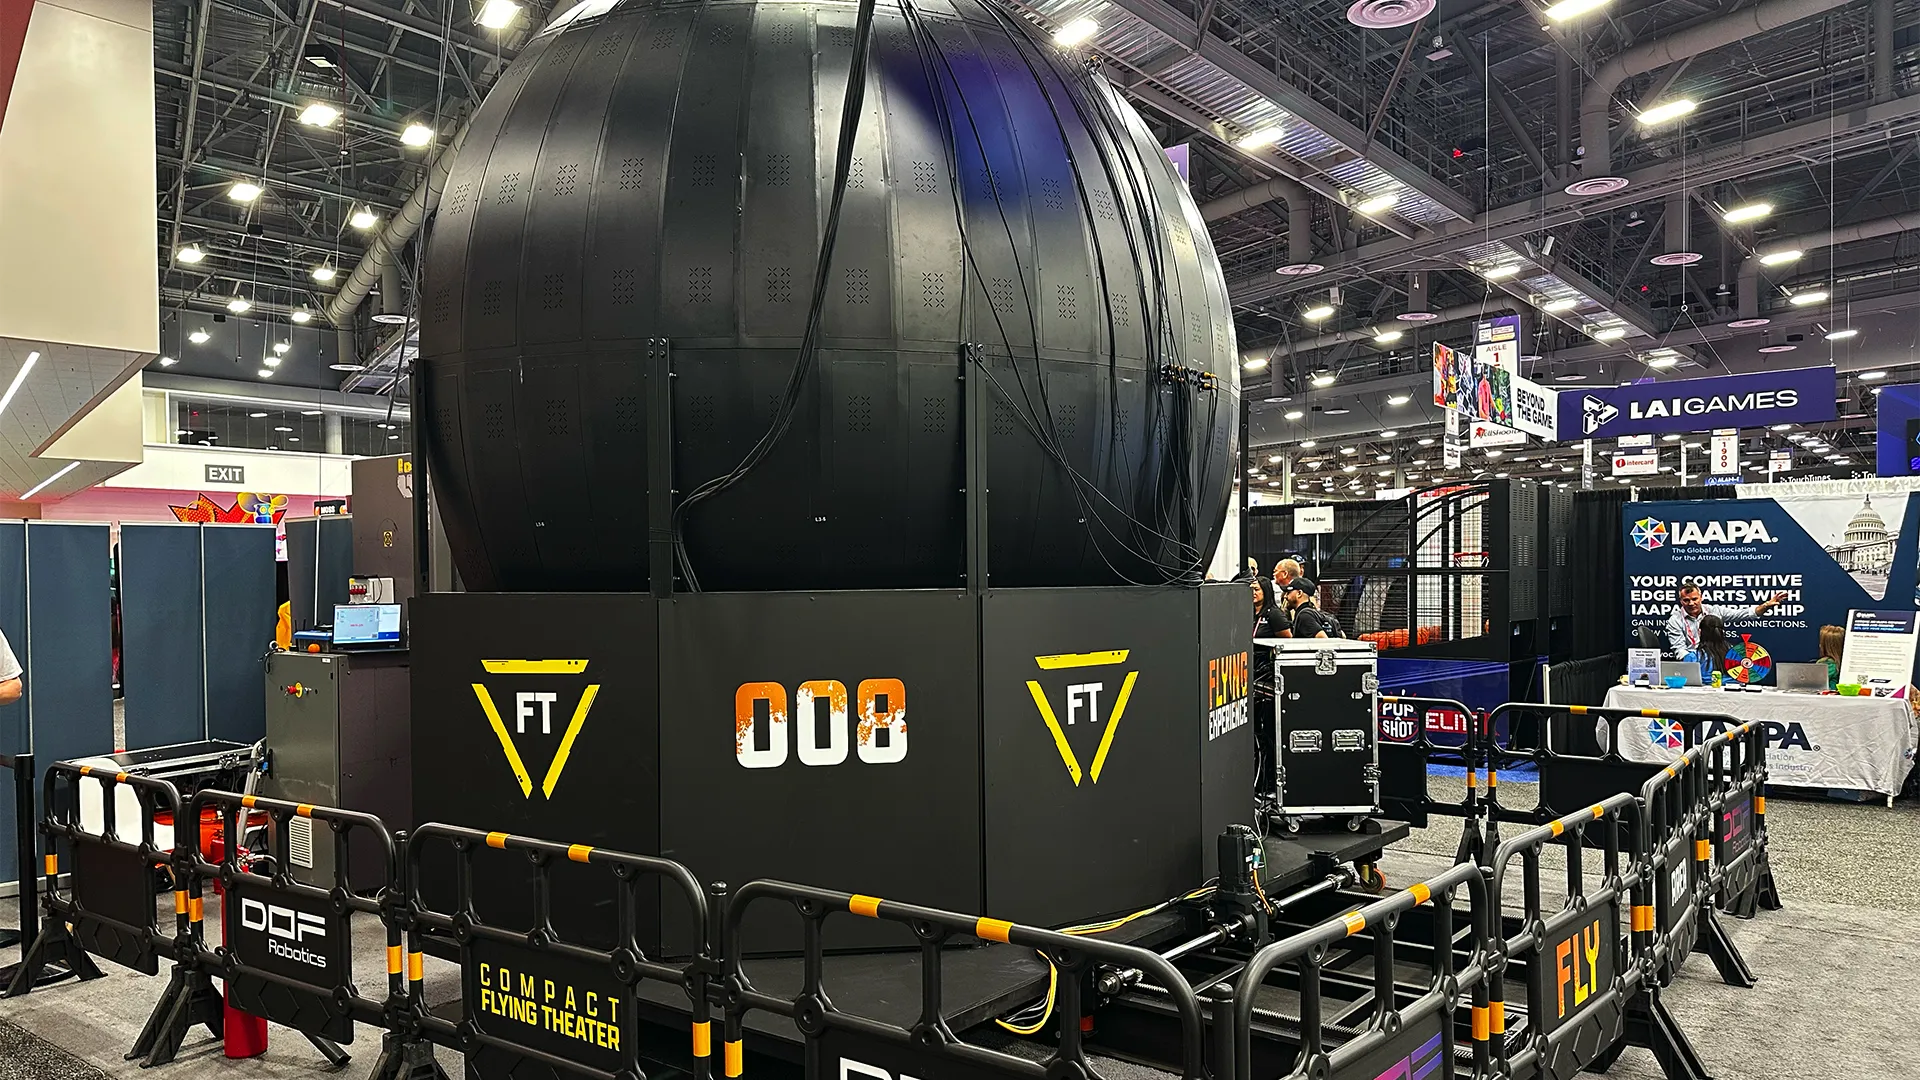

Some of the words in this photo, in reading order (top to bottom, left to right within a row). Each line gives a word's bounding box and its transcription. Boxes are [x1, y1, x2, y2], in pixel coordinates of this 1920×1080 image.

[1486, 344, 1507, 352] AISLE
[1517, 388, 1544, 410] BEYOND
[1517, 405, 1532, 422] THE
[209, 467, 242, 482] EXIT
[1630, 576, 1677, 587] YOUR
[1682, 574, 1802, 587] COMPETITIVE
[1630, 590, 1676, 601] EDGE
[1209, 652, 1247, 710] FLYING
[516, 692, 557, 734] FT
[1067, 682, 1103, 725] FT
[1209, 696, 1247, 741] EXPERIENCE
[736, 678, 908, 768] 008
[1382, 720, 1414, 738] SHOT
[1776, 763, 1812, 772] Industry
[242, 898, 325, 942] DOF
[269, 938, 326, 968] Robotics
[1556, 920, 1599, 1019] FLY
[480, 963, 619, 1022] COMPACT
[481, 988, 537, 1025] FLYING
[541, 1005, 620, 1051] THEATER
